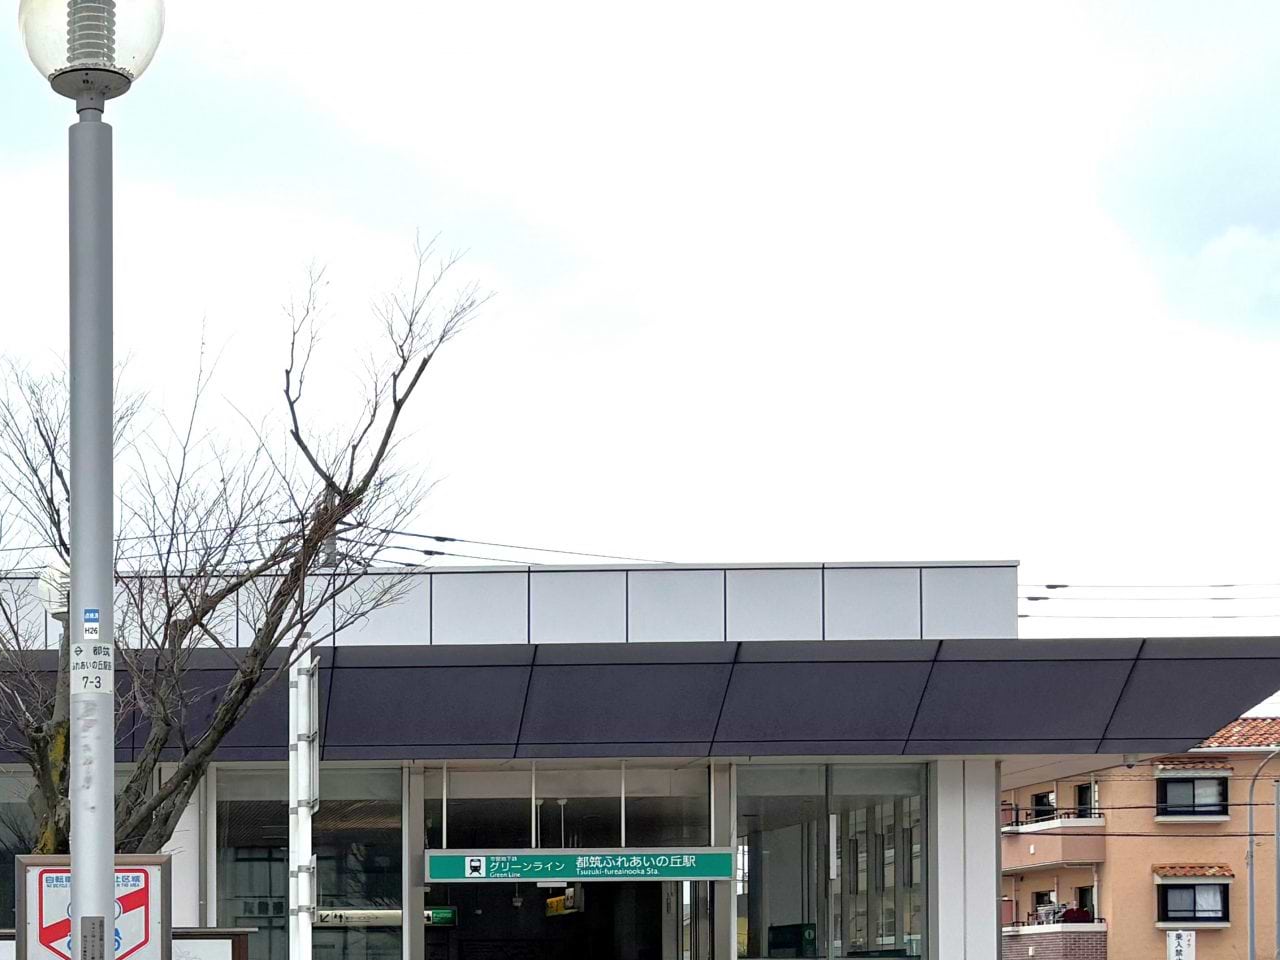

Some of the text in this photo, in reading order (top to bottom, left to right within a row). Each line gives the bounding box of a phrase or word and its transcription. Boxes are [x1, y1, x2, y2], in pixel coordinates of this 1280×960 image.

[85, 627, 98, 635] H26
[93, 646, 111, 656] 都筑
[82, 676, 102, 689] 7-3
[489, 861, 565, 872] グリーンライン
[576, 855, 697, 868] 都筑ふれあいの丘駅
